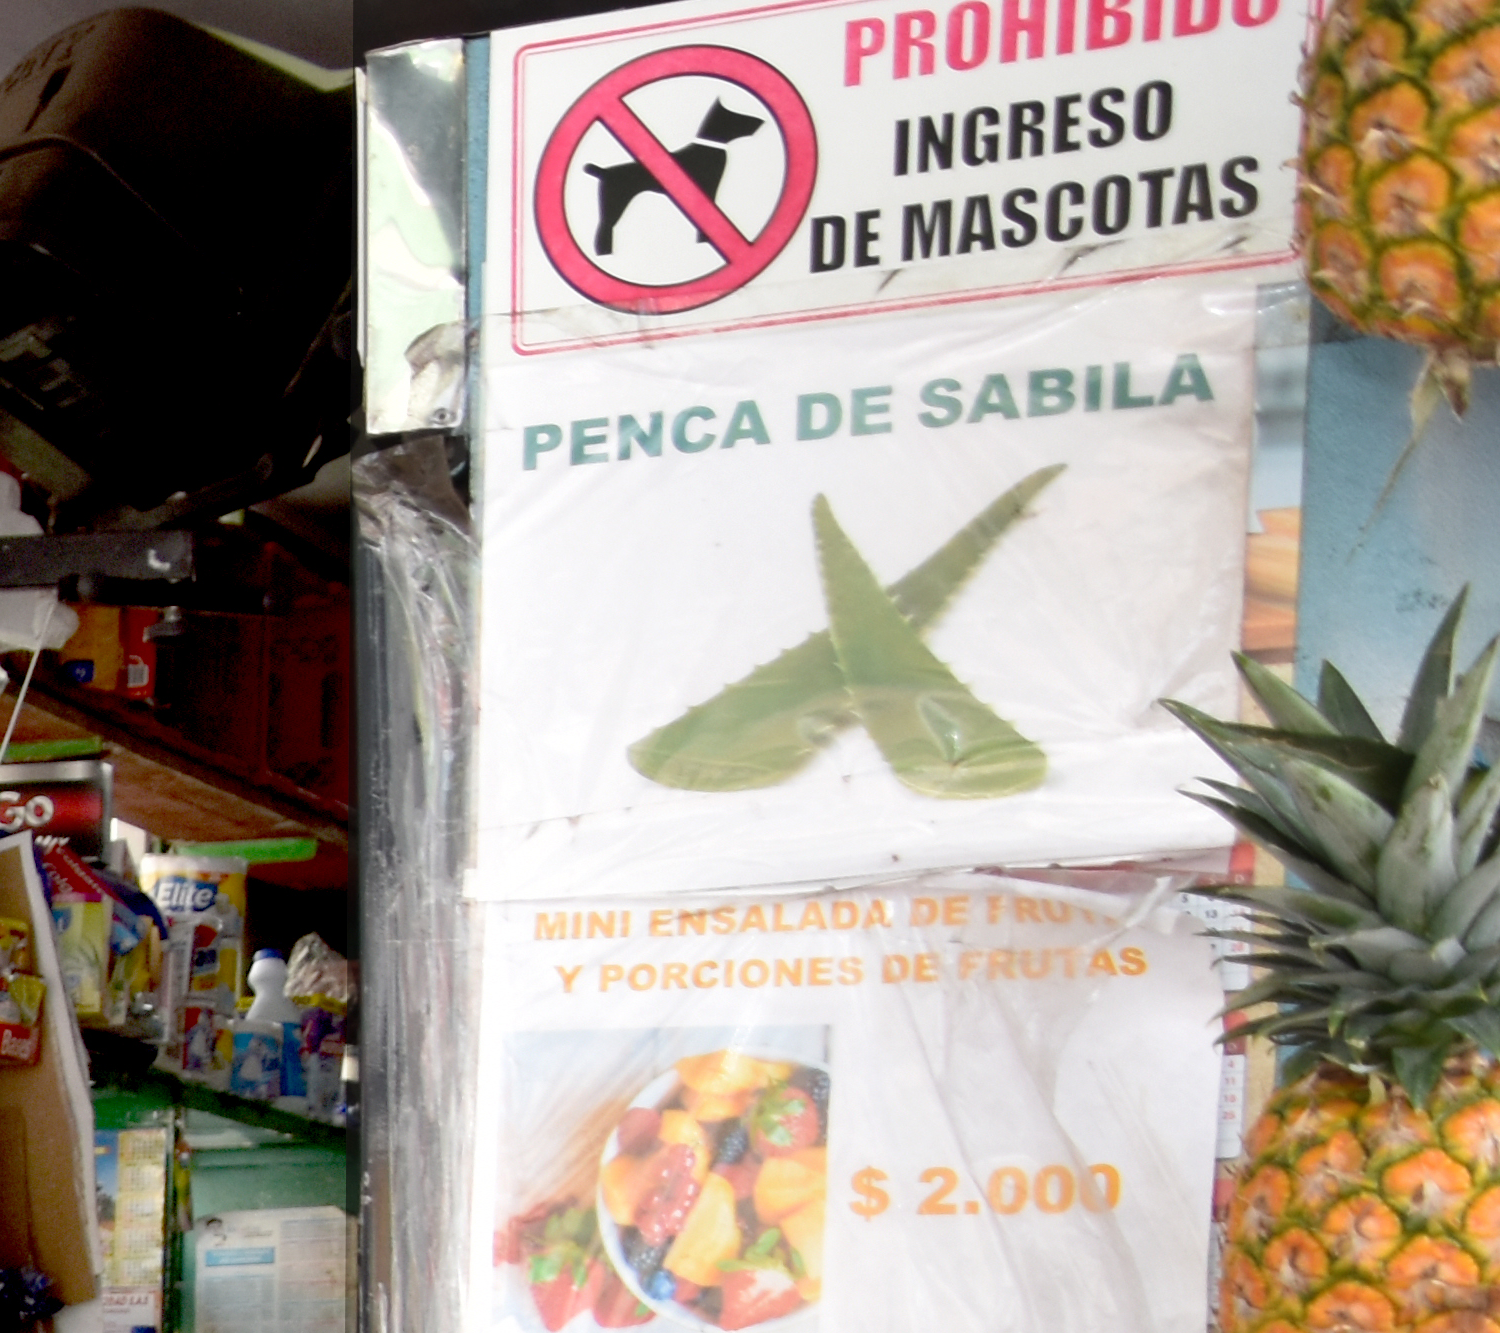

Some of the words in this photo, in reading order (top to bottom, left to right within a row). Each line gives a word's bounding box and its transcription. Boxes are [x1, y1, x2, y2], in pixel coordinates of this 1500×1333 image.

[893, 79, 1175, 177] INGRESO
[810, 207, 882, 274] DE
[900, 155, 1261, 263] MASCOTAS
[521, 398, 771, 471] PENCA
[794, 385, 894, 443] DE
[918, 353, 1215, 430] SABILA
[157, 882, 213, 912] Elite
[533, 907, 633, 942] MINI
[648, 898, 892, 939] ENSALADA
[910, 895, 963, 929] DE
[986, 895, 1120, 929] FRU
[555, 962, 579, 995] Y
[597, 953, 867, 993] PORCIONES
[880, 951, 941, 985] DE
[957, 944, 1149, 983] FRUTAS
[850, 1164, 890, 1221] $
[915, 1162, 1122, 1217] 2.000
